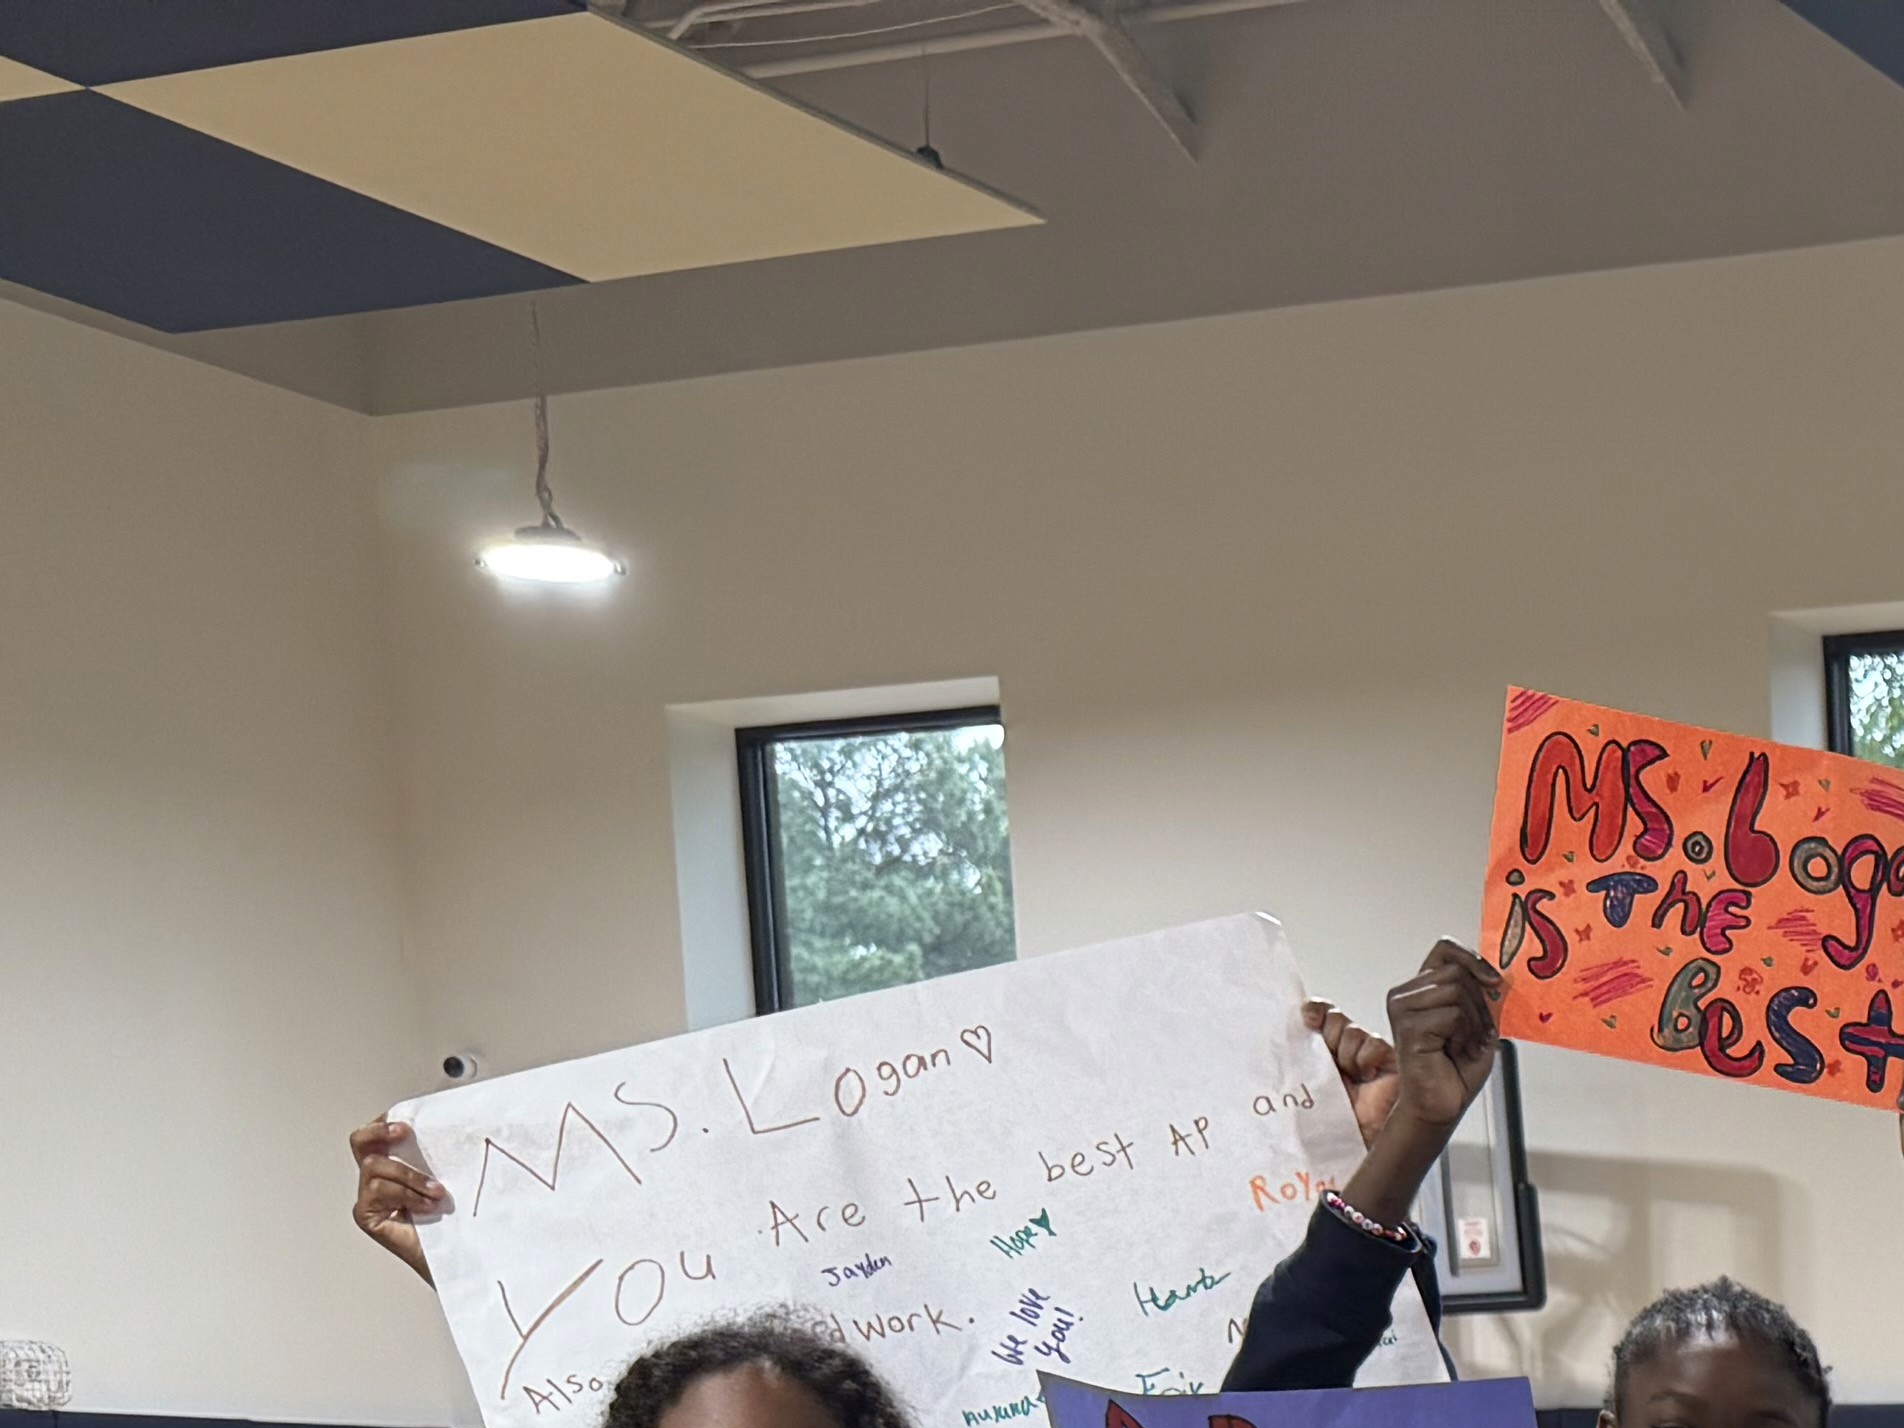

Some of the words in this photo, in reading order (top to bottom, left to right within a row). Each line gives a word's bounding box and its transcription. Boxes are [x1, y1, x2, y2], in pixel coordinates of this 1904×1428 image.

[1499, 868, 1570, 981] is
[723, 1043, 952, 1136] Logan
[498, 1250, 716, 1401] You
[770, 1200, 866, 1246] Are
[904, 1175, 996, 1222] the
[1041, 1132, 1134, 1182] best
[1169, 1116, 1210, 1156] AP
[1253, 1083, 1315, 1117] and
[1009, 1287, 1051, 1327] love
[1034, 1306, 1084, 1364] you!
[523, 1374, 604, 1414] Also
